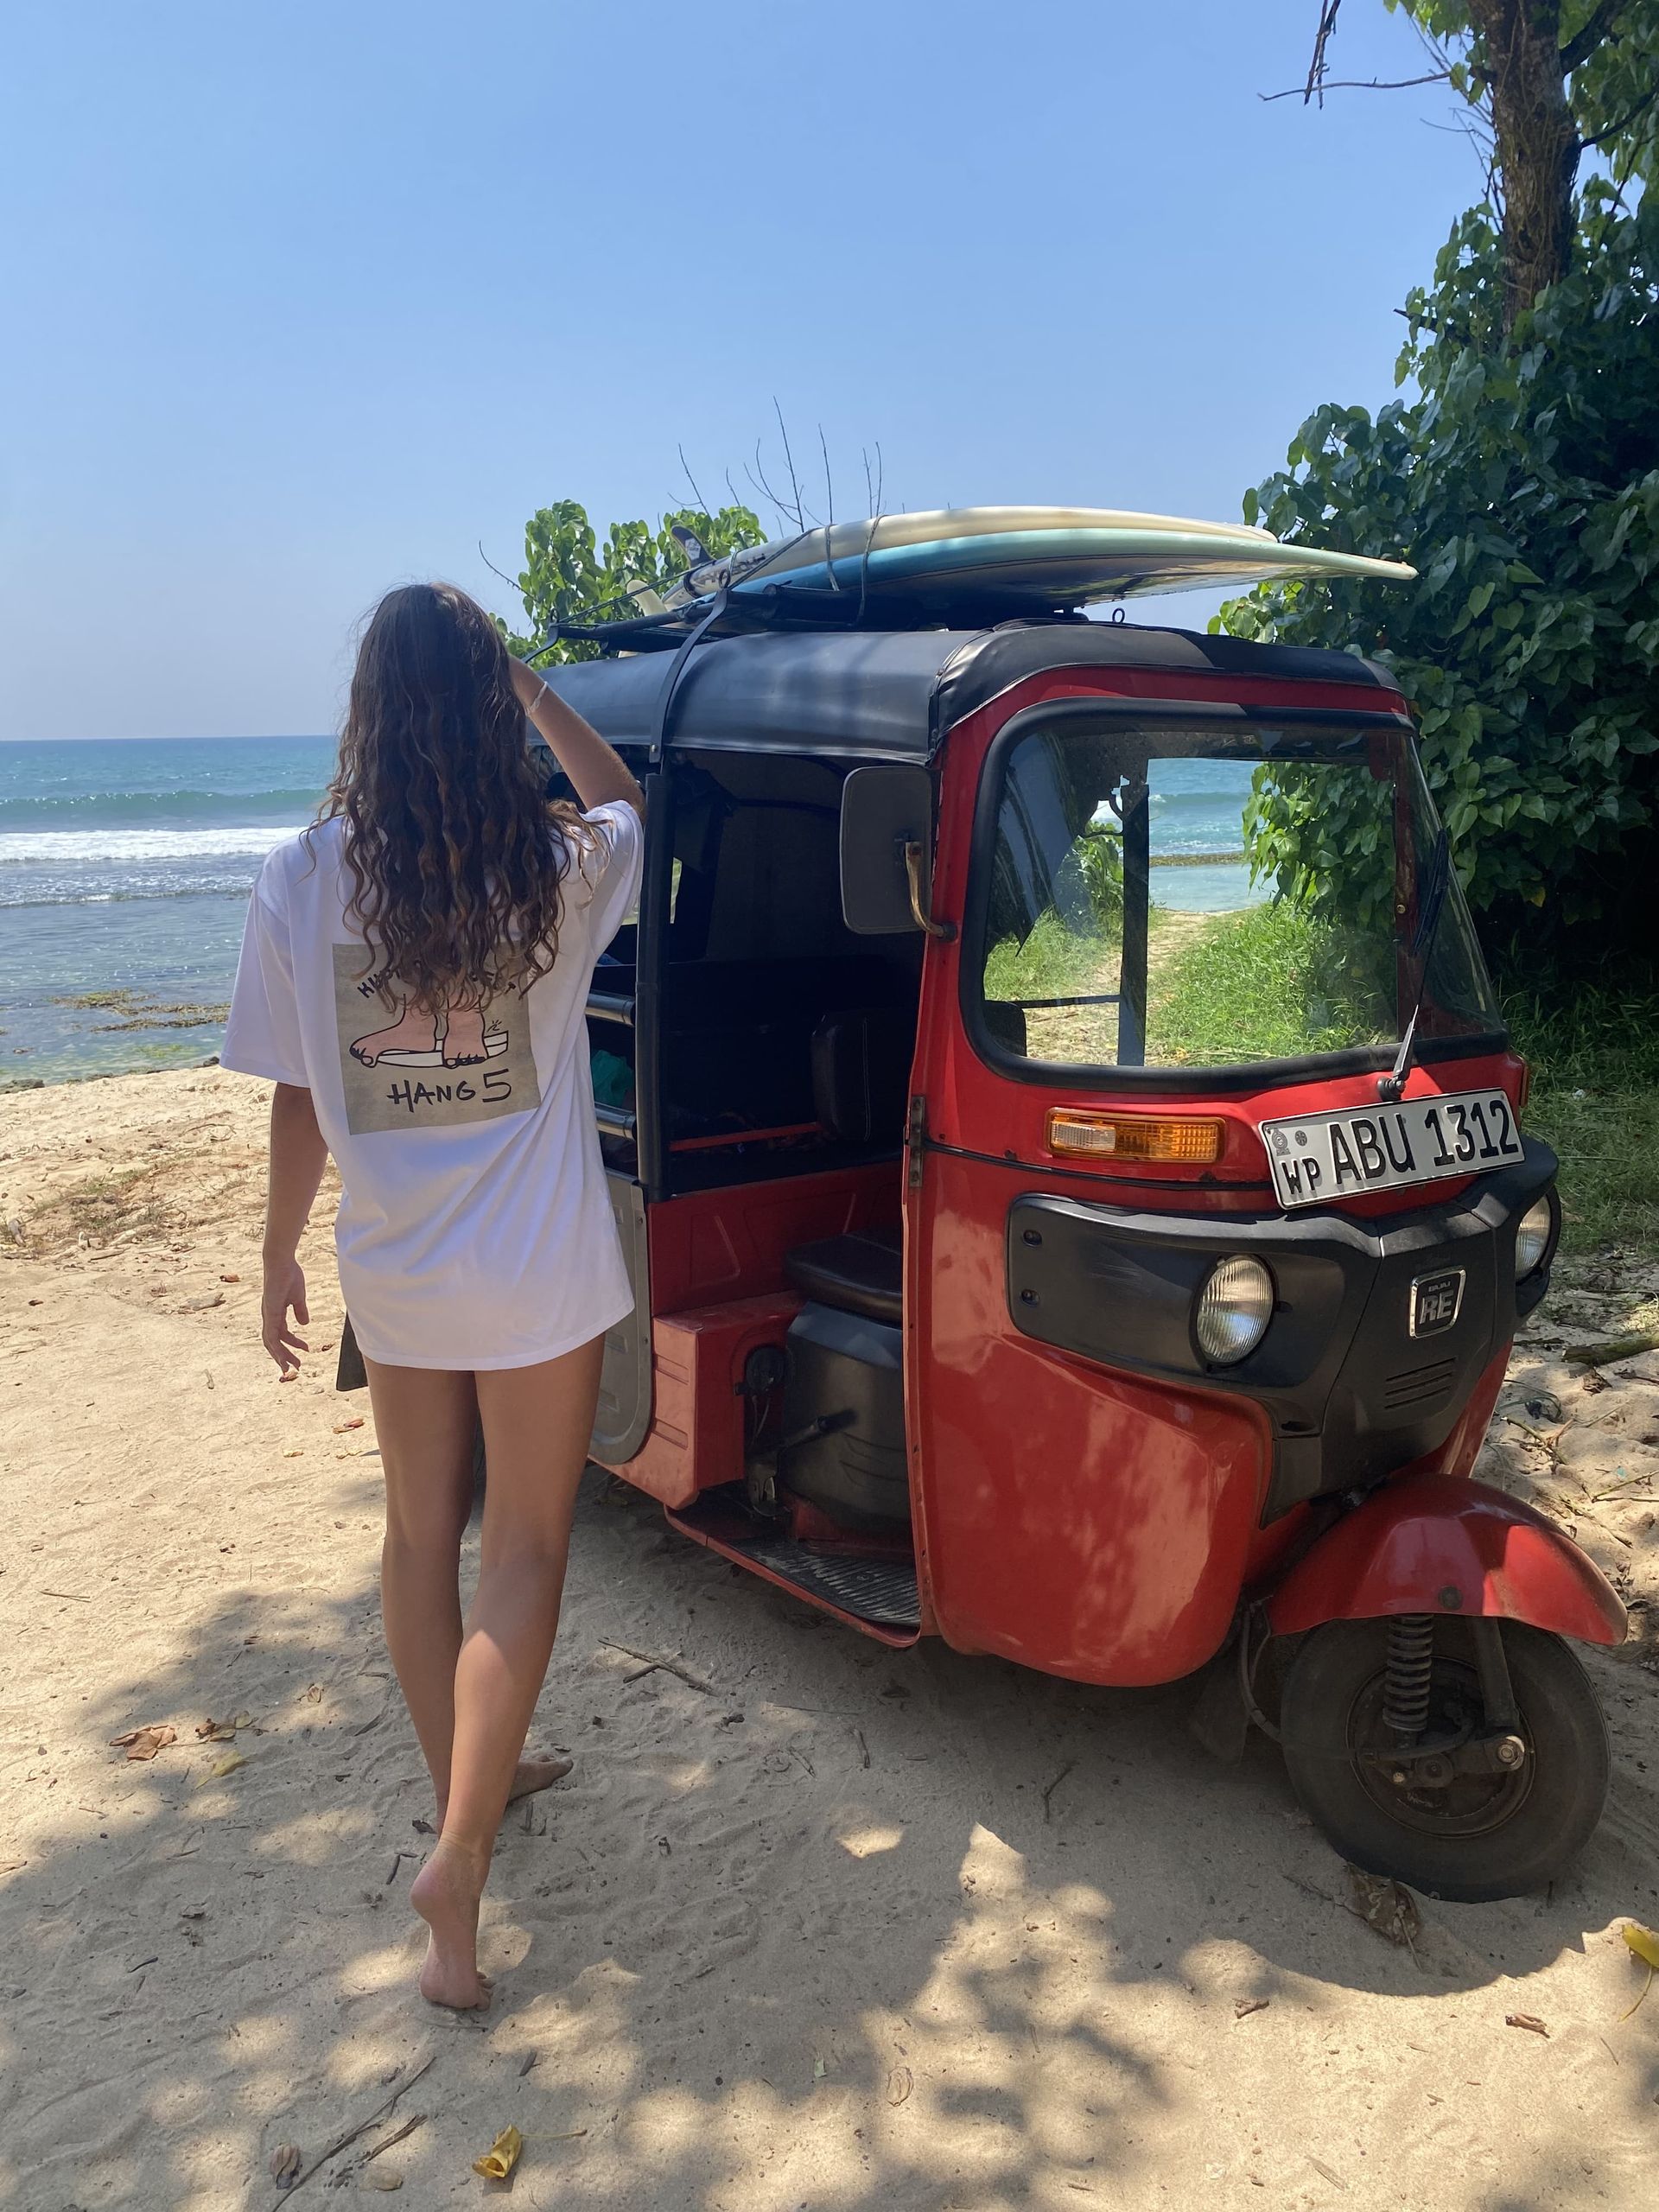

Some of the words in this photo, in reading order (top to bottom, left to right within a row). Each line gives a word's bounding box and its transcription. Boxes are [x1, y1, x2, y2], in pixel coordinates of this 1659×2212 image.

[387, 1079, 476, 1113] HANG
[482, 1068, 512, 1103] 5
[1281, 1158, 1320, 1195] WP
[1328, 1114, 1416, 1185] ABU
[1425, 1100, 1519, 1166] 1312
[1419, 1289, 1454, 1325] RE
